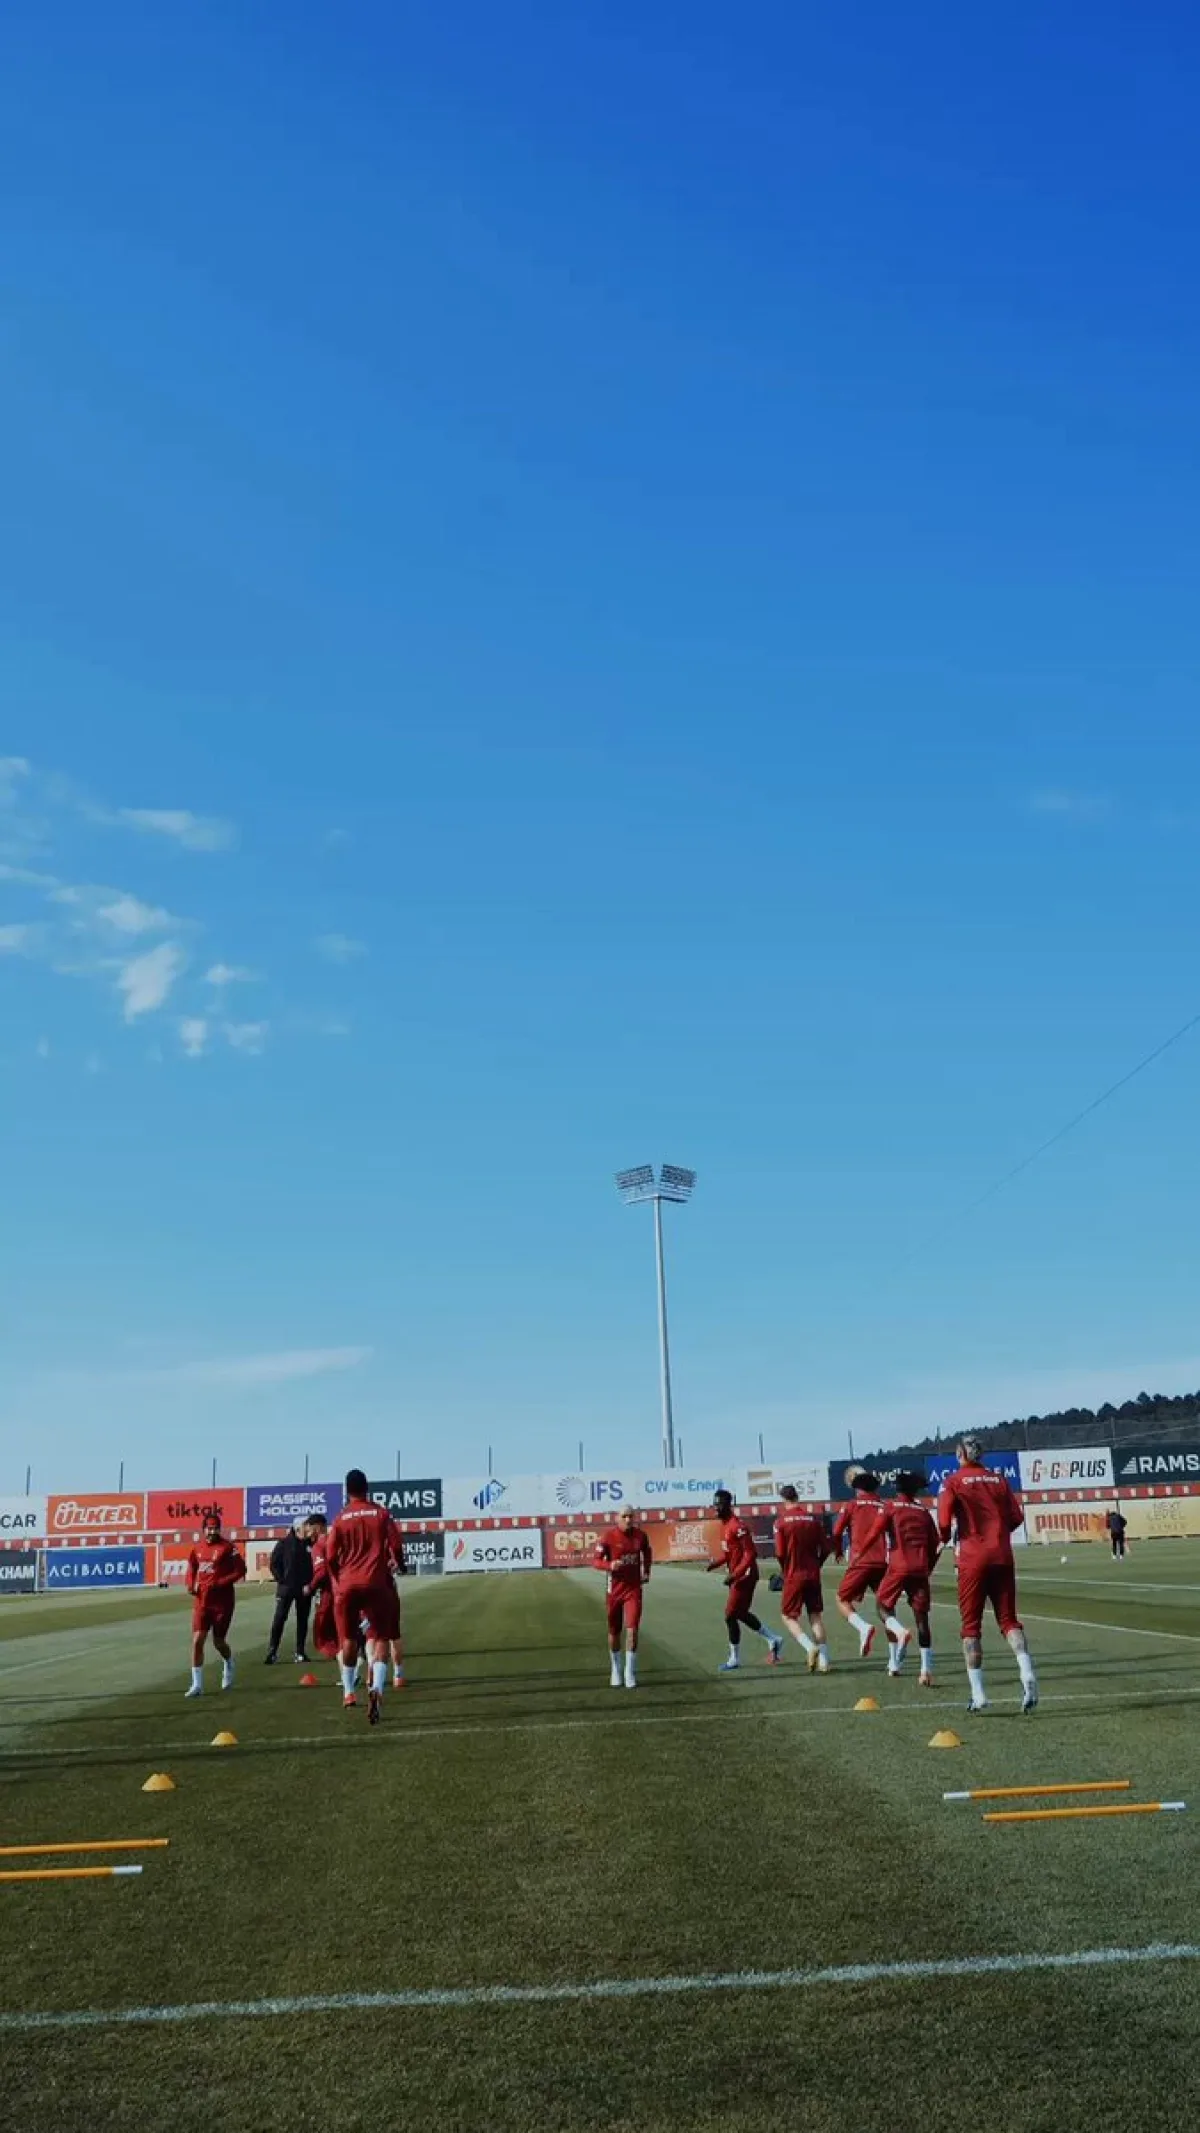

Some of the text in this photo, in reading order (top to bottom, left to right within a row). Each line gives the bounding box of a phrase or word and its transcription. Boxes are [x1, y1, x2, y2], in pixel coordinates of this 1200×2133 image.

[1138, 1453, 1200, 1473] RAMS
[590, 1480, 624, 1501] IFS
[644, 1480, 669, 1493] CW
[373, 1489, 437, 1511] RAMS
[54, 1501, 137, 1530] ÜLKER
[259, 1505, 328, 1517] HOLDING
[1035, 1512, 1089, 1533] PUMA
[472, 1546, 535, 1563] SOCAR
[48, 1560, 140, 1578] ACIBADEM
